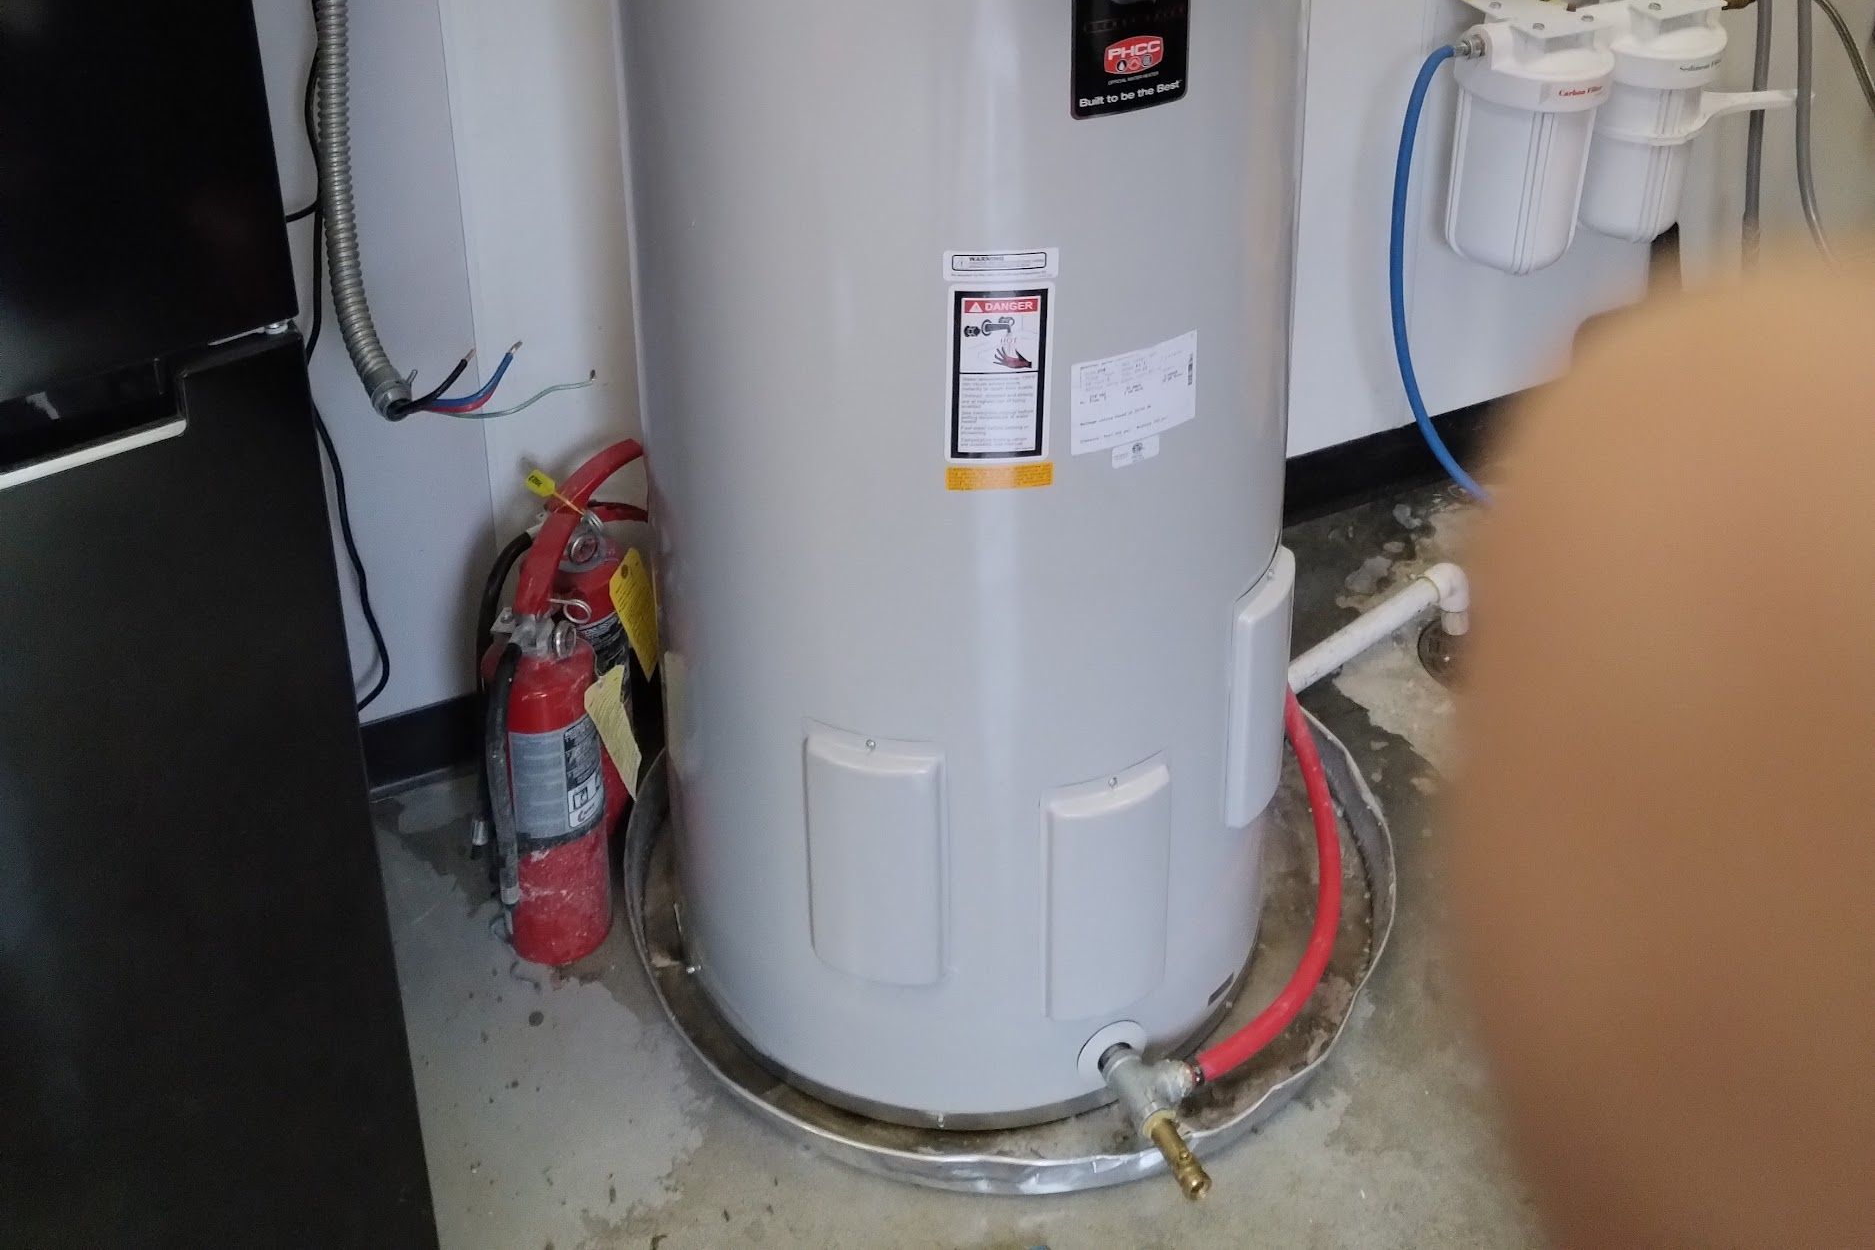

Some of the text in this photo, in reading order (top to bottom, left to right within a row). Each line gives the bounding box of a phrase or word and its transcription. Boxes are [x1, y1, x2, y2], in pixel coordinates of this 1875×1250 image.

[1108, 40, 1160, 61] PHCC
[1079, 95, 1105, 108] Built
[1106, 94, 1119, 103] to
[1120, 91, 1135, 101] be
[1137, 87, 1155, 98] the
[984, 301, 1033, 311] DANGER
